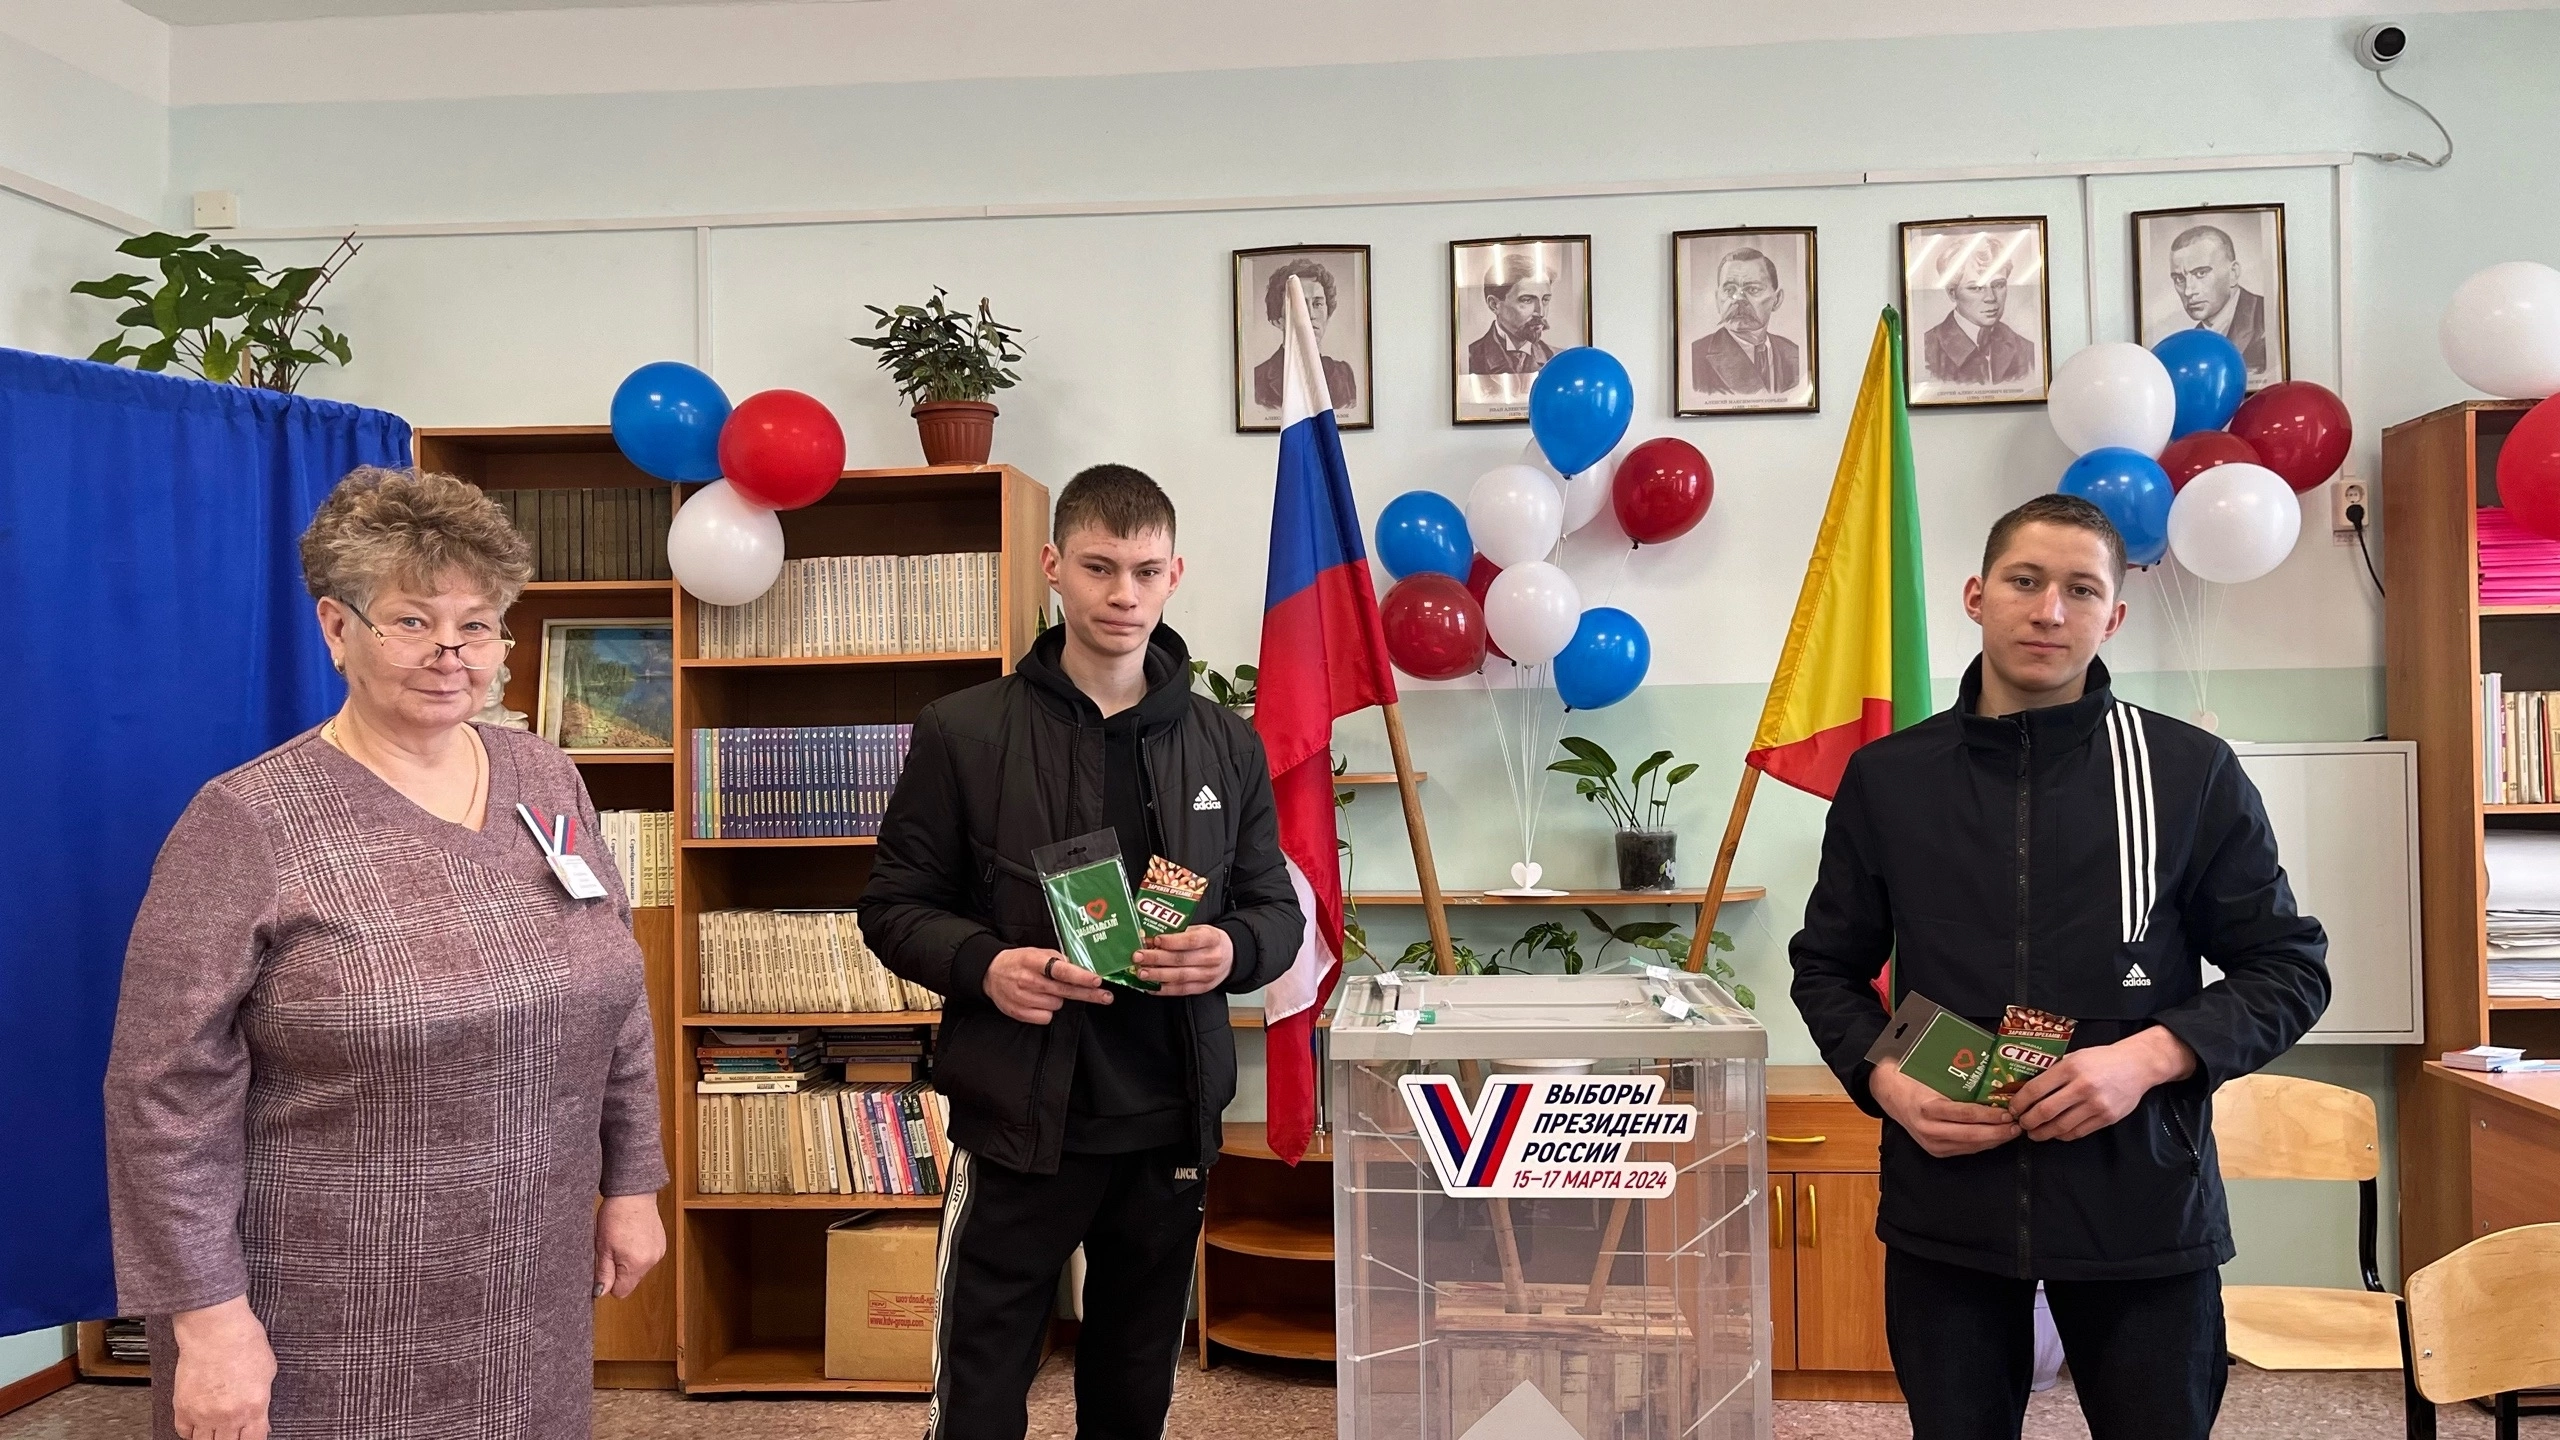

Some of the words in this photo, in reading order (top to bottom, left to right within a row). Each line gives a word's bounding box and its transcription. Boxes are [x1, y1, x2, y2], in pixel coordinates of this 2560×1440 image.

[1192, 800, 1222, 811] adidas
[1077, 905, 1090, 926] Я
[1139, 899, 1183, 926] СТЕП
[2121, 976, 2152, 987] adidas
[2007, 1029, 2034, 1037] ЗАРЯЖЕН
[2001, 1045, 2055, 1068] СТЕП
[1947, 1065, 1969, 1081] Я
[1543, 1083, 1655, 1105] ВЫБОРЫ
[1532, 1112, 1689, 1137] ПРЕЗИДЕНТА
[1520, 1142, 1622, 1163] РОССИИ
[1562, 1170, 1621, 1189] МАРТА
[1623, 1169, 1668, 1190] 2024
[869, 1316, 925, 1329] www.kdv-group.com
